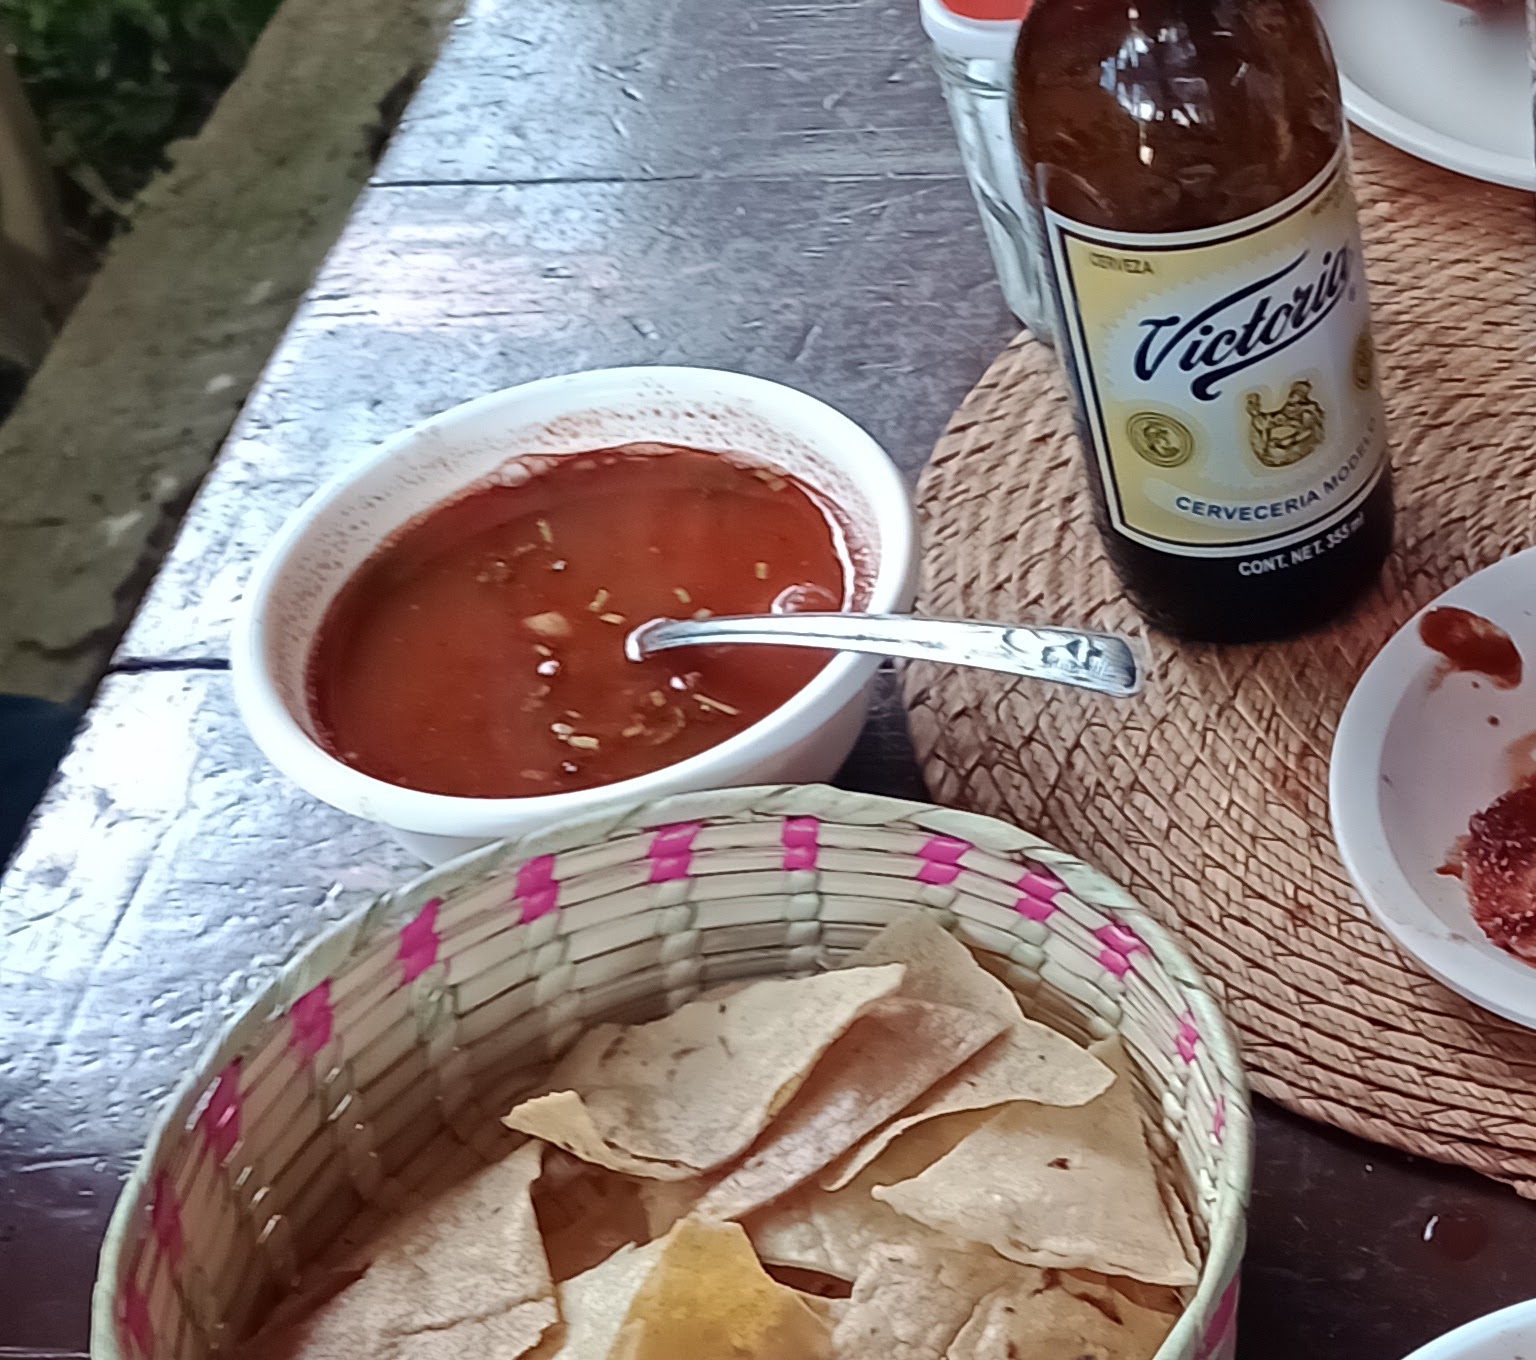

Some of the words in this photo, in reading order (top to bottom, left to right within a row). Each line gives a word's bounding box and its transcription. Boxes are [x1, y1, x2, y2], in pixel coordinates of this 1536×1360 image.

[1132, 240, 1351, 402] Victoria
[1175, 488, 1321, 523] CERVECERIA
[1237, 553, 1289, 578] CONT.
